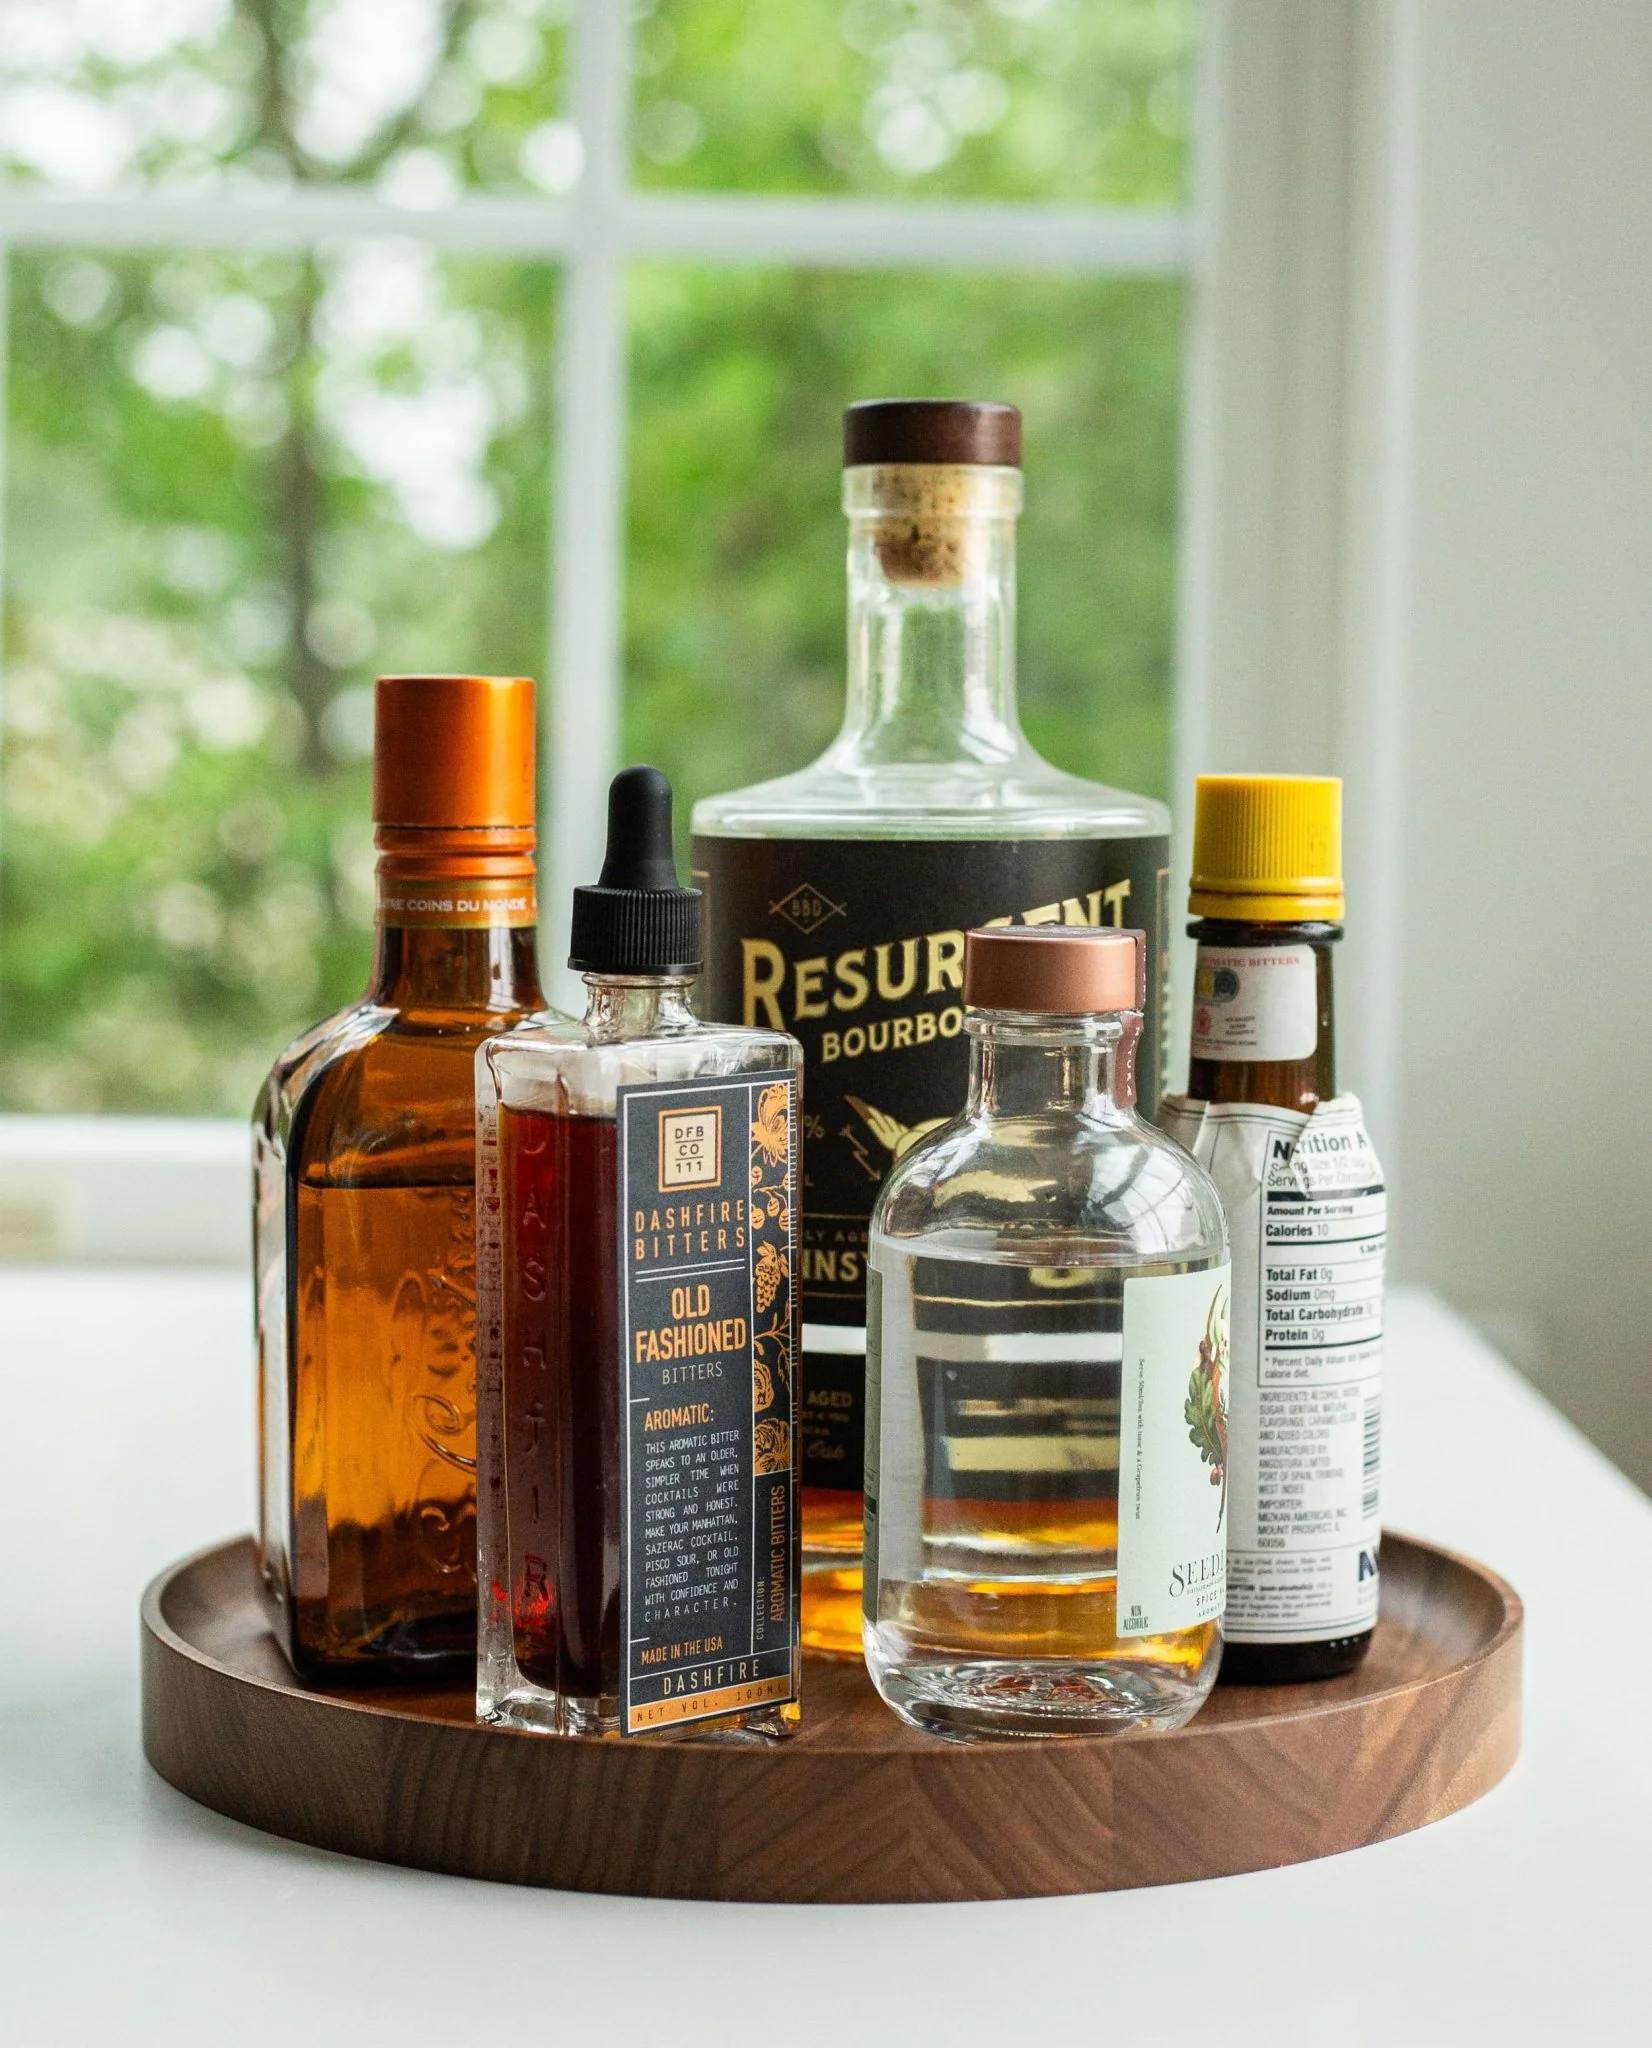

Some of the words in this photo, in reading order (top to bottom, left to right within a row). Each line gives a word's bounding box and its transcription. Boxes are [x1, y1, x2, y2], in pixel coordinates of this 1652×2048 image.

[406, 898, 454, 912] COINS
[456, 899, 480, 913] DU
[483, 897, 527, 912] MONDE
[674, 1125, 705, 1140] DFB
[679, 1143, 700, 1157] CO
[675, 1160, 703, 1174] 111
[635, 1199, 745, 1234] DASHFIRE
[1267, 1206, 1304, 1216] Amount
[1307, 1206, 1321, 1215] Per
[1265, 1223, 1313, 1237] Calories
[1316, 1223, 1329, 1236] 10
[635, 1226, 745, 1262] BITTERS
[1265, 1268, 1296, 1281] Total
[1299, 1267, 1317, 1281] Fat
[1320, 1266, 1333, 1282] 0g
[671, 1283, 711, 1321] OLD
[1265, 1287, 1311, 1302] Sodium
[1265, 1308, 1295, 1321] Total
[1298, 1305, 1364, 1321] Carbohydrate
[635, 1316, 747, 1364] FASHIONED
[1265, 1328, 1309, 1341] Protein
[1311, 1327, 1325, 1342] 0g
[662, 1360, 723, 1386] BITTERS
[644, 1402, 715, 1432] AROMATIC:
[645, 1441, 666, 1455] THIS
[668, 1435, 708, 1451] AROMATIC
[710, 1429, 740, 1445] BITTER
[645, 1456, 675, 1472] SPEAKS
[681, 1454, 691, 1466] TO
[695, 1452, 706, 1464] AN
[645, 1472, 680, 1489] SIMPLER
[690, 1467, 710, 1481] TIME
[719, 1463, 740, 1476] WHEN
[645, 1486, 699, 1506] COCKTAILS
[716, 1479, 740, 1494] WERE
[645, 1506, 676, 1522] STRONG
[683, 1503, 699, 1516] AND
[770, 1484, 785, 1545] BITTERS
[645, 1525, 666, 1539] MAKE
[669, 1521, 689, 1535] YOUR
[645, 1538, 684, 1556] SAZERAC
[645, 1558, 670, 1573] PISCO
[676, 1553, 700, 1567] SOUR,
[707, 1549, 718, 1561] OR
[723, 1545, 739, 1558] OLD
[645, 1571, 689, 1589] FASHIONED
[705, 1561, 739, 1578] TONIGHT
[770, 1548, 785, 1623] AROMATIC
[644, 1592, 665, 1606] WITH
[670, 1582, 718, 1601] CONFIDENCE
[723, 1578, 739, 1591] AND
[1196, 1590, 1217, 1606] SPICE
[756, 1576, 765, 1641] COLLECTION:
[1131, 1604, 1142, 1617] NON
[641, 1646, 668, 1666] MADE
[670, 1642, 681, 1660] IN
[684, 1639, 701, 1657] THE
[704, 1635, 723, 1653] USA
[663, 1658, 760, 1695] DASHFIRE
[637, 1707, 664, 1722] NET
[682, 1698, 718, 1713] VOL.
[736, 1683, 785, 1702] 100ML
